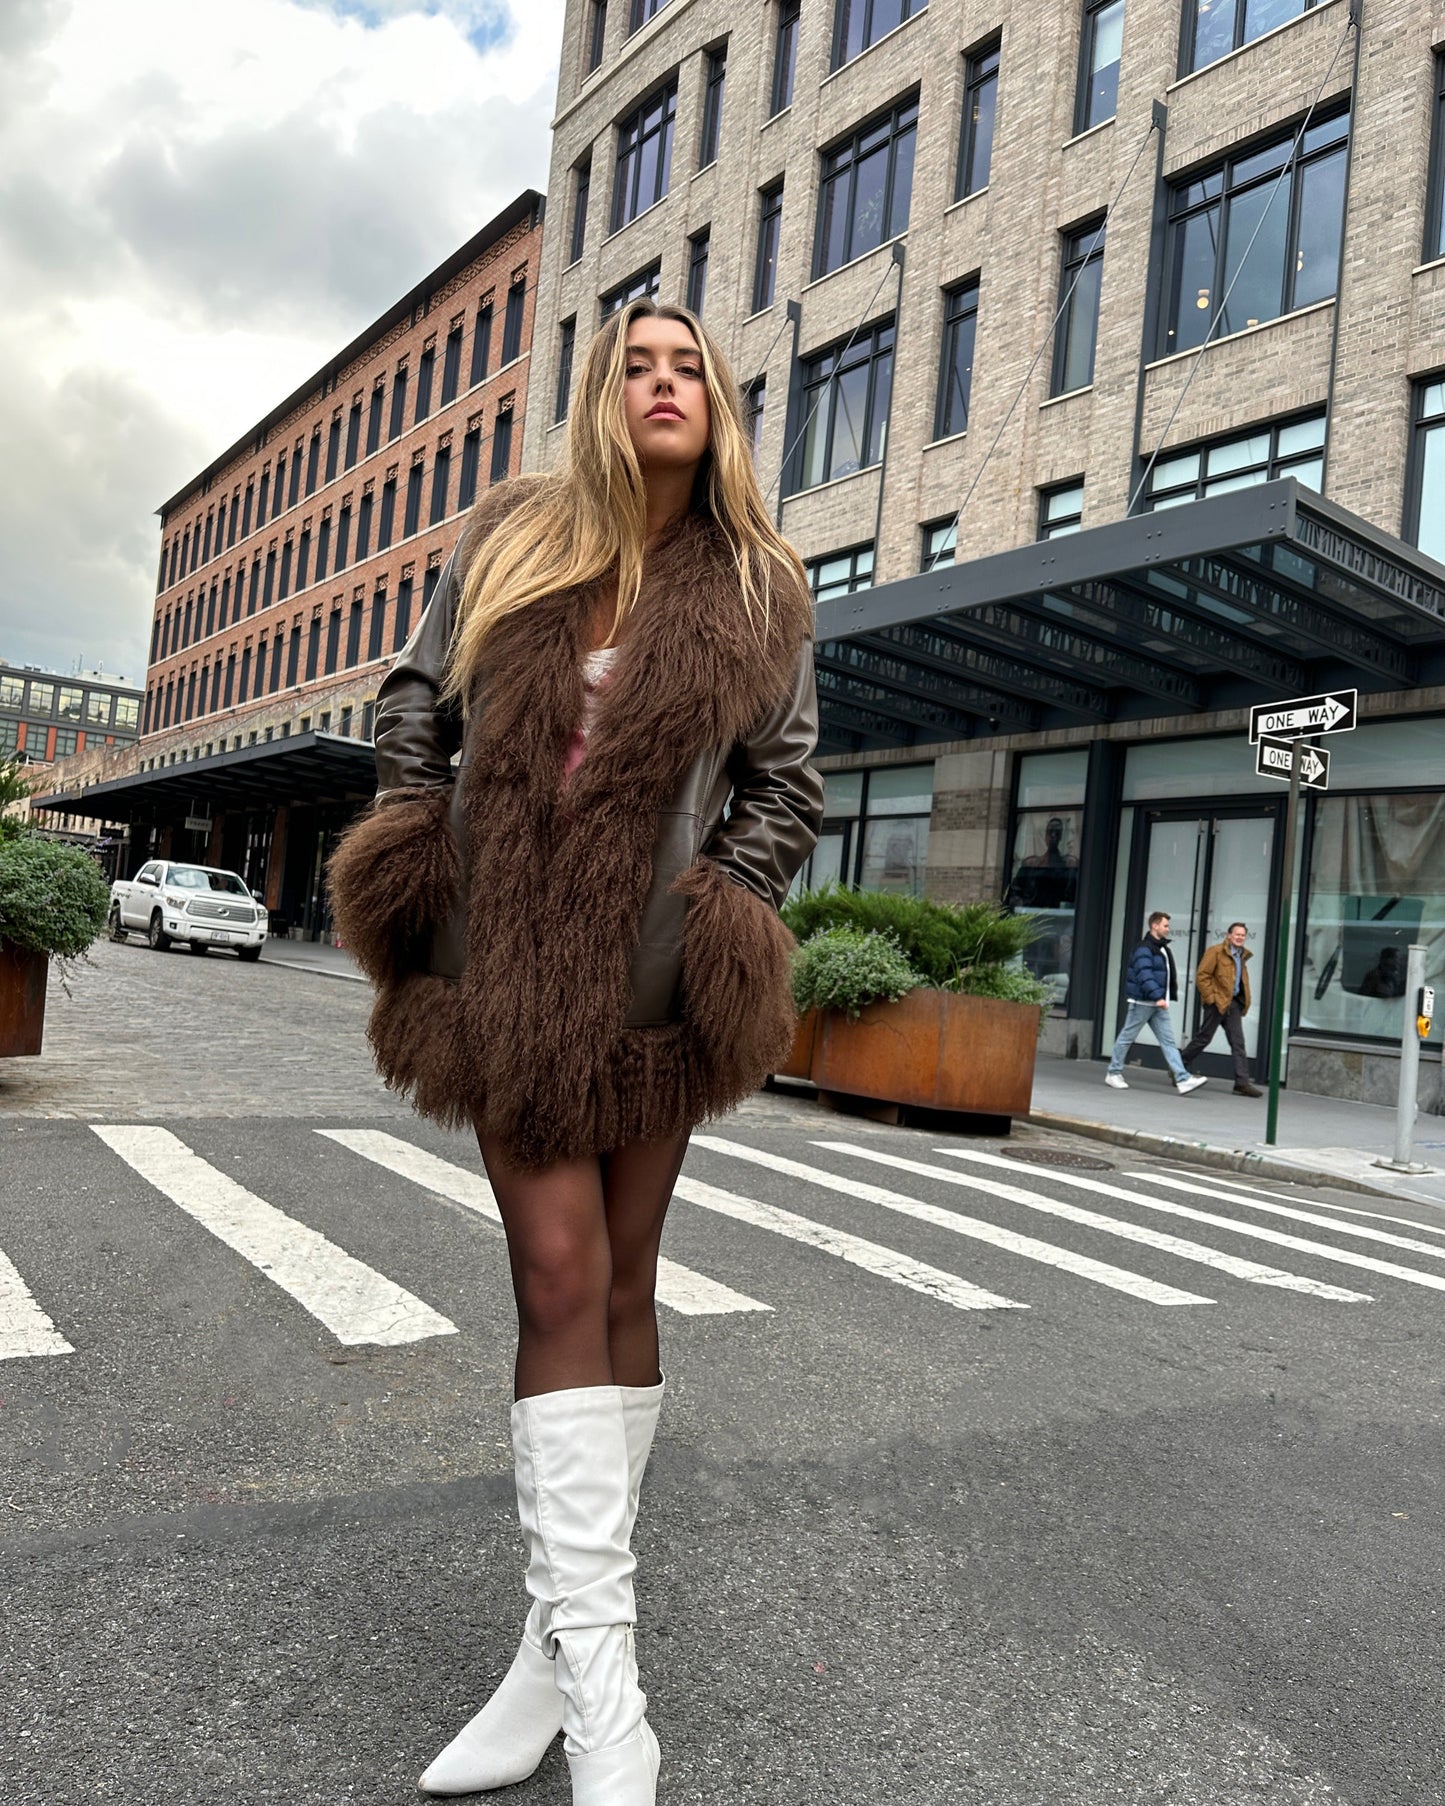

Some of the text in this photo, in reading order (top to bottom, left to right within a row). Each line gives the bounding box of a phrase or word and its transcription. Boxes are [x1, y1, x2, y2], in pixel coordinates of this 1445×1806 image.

[1265, 705, 1339, 730] ONE WAY
[1269, 750, 1290, 768] ONE
